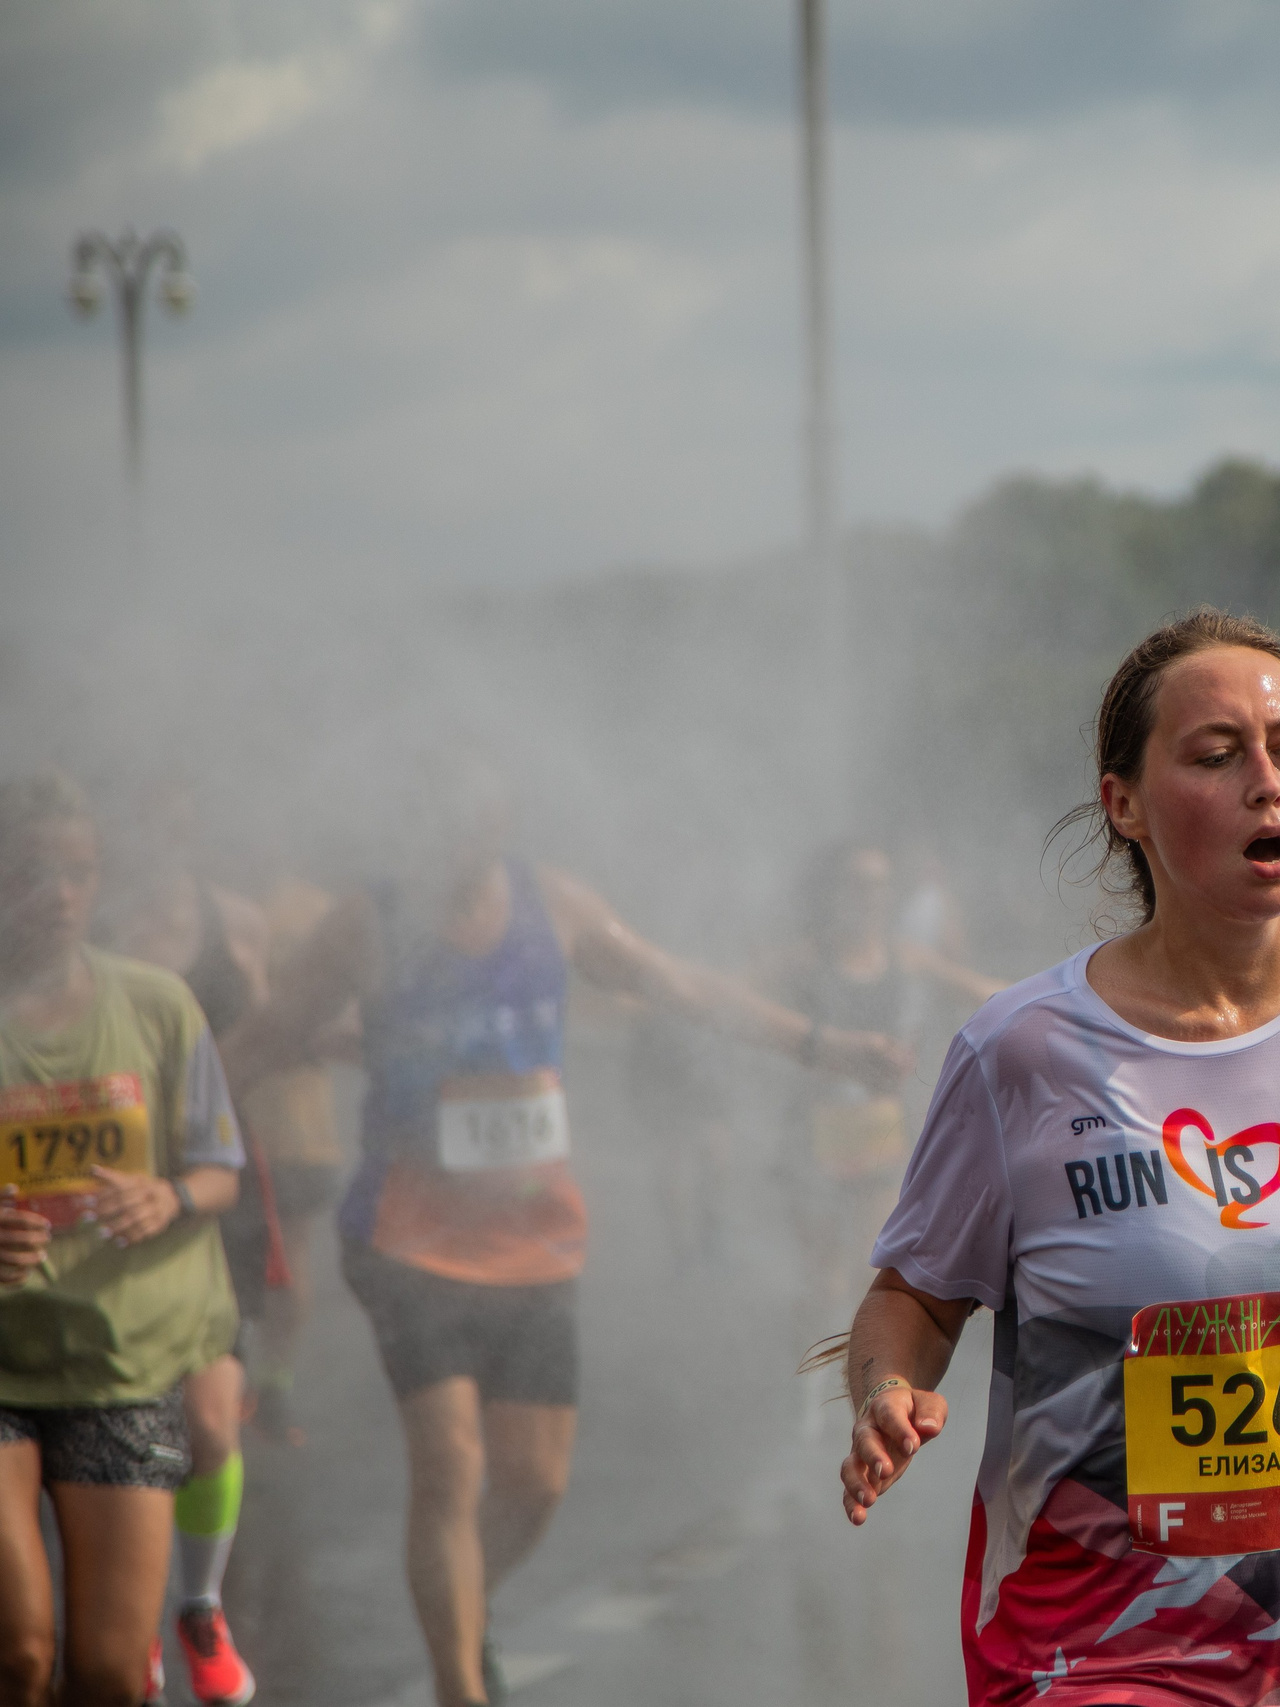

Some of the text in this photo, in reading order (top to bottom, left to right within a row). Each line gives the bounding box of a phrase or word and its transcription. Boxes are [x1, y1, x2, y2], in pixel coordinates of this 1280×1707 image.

[8, 1120, 126, 1170] 1790
[1064, 1150, 1169, 1219] RUN
[1206, 1145, 1262, 1207] IS
[1159, 1502, 1185, 1541] F
